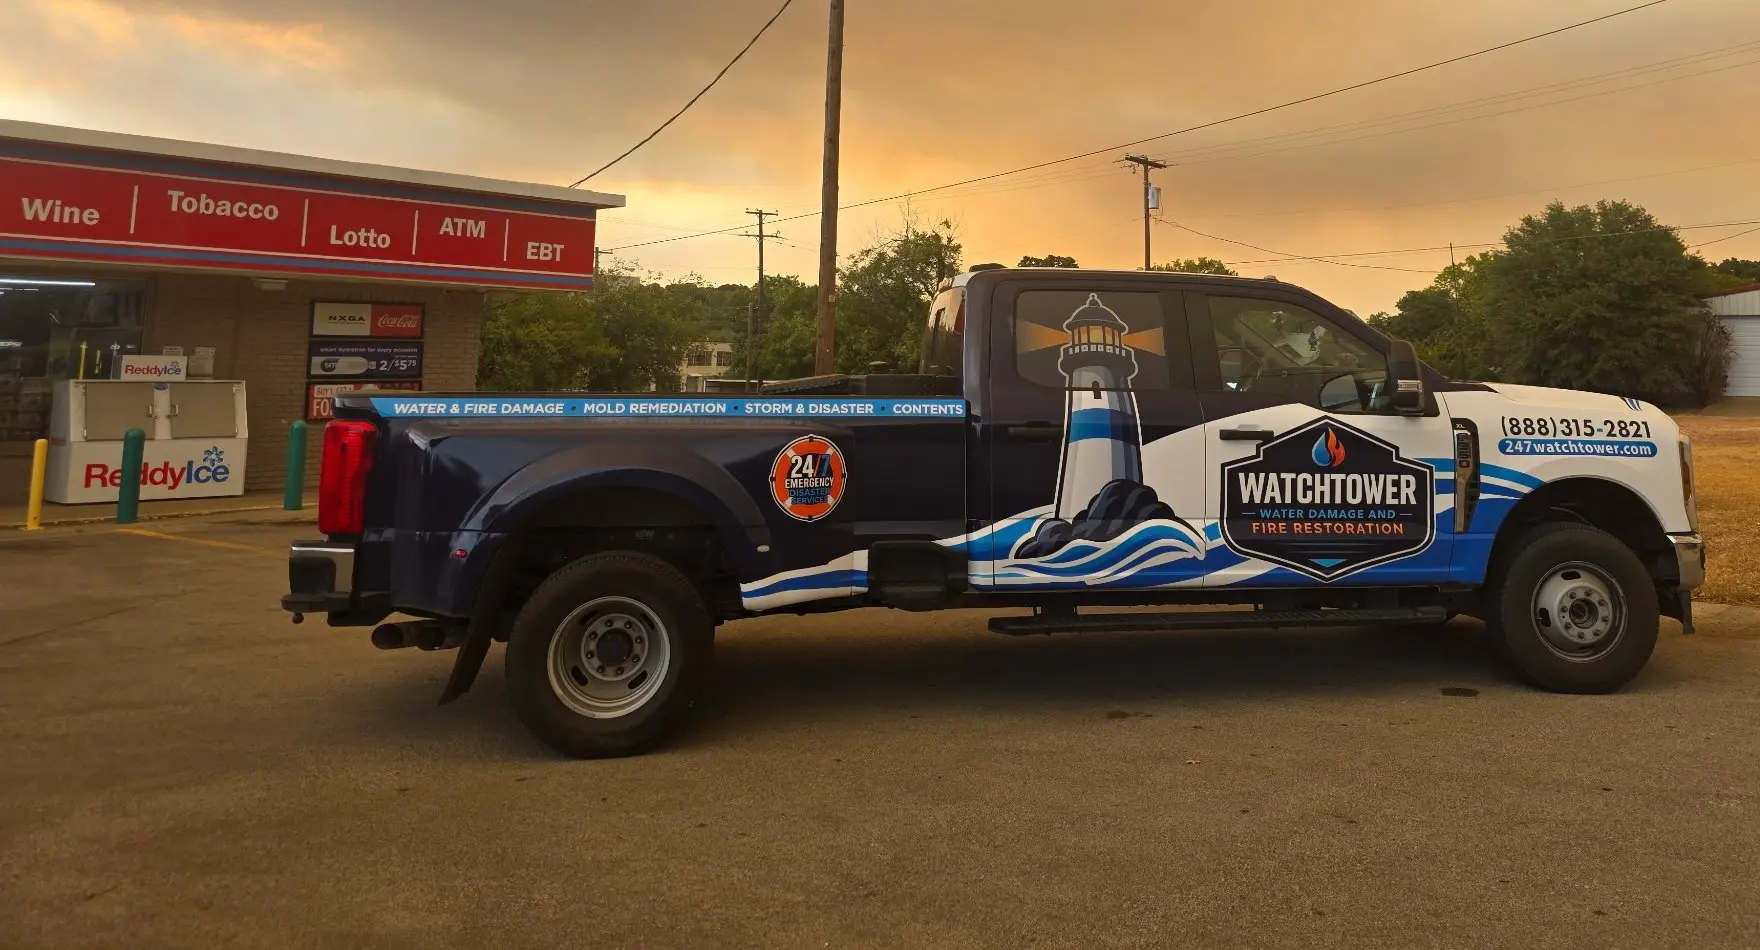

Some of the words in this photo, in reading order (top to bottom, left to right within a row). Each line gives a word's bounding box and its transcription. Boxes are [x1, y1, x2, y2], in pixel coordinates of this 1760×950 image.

[21, 197, 100, 226] Wine
[167, 189, 280, 221] Tobacco
[439, 217, 486, 239] ATM
[329, 225, 392, 249] Lotto
[526, 241, 565, 262] EBT
[124, 362, 182, 377] ReddyIce
[313, 398, 333, 417] FO
[394, 403, 447, 414] WATER
[450, 403, 460, 414] &
[464, 403, 498, 414] FIRE
[501, 403, 565, 414] DAMAGE
[583, 403, 626, 414] MOLD
[629, 403, 727, 414] REMEDIATION
[745, 403, 792, 414] STORM
[796, 403, 805, 414] &
[809, 403, 874, 414] DISASTER
[892, 404, 964, 415] CONTENTS
[1505, 440, 1652, 456] 247watchtower.com
[791, 454, 830, 478] 24/7
[785, 477, 834, 489] EMERGENCY
[1238, 472, 1417, 505] WATCHTOWER
[790, 488, 830, 497] DISASTER
[791, 496, 829, 504] SERVICES
[1259, 509, 1304, 519] WATER
[1308, 509, 1364, 519] DAMAGE
[1368, 509, 1396, 519] AND
[1252, 522, 1288, 534] FIRE
[1293, 522, 1404, 535] RESTORATION
